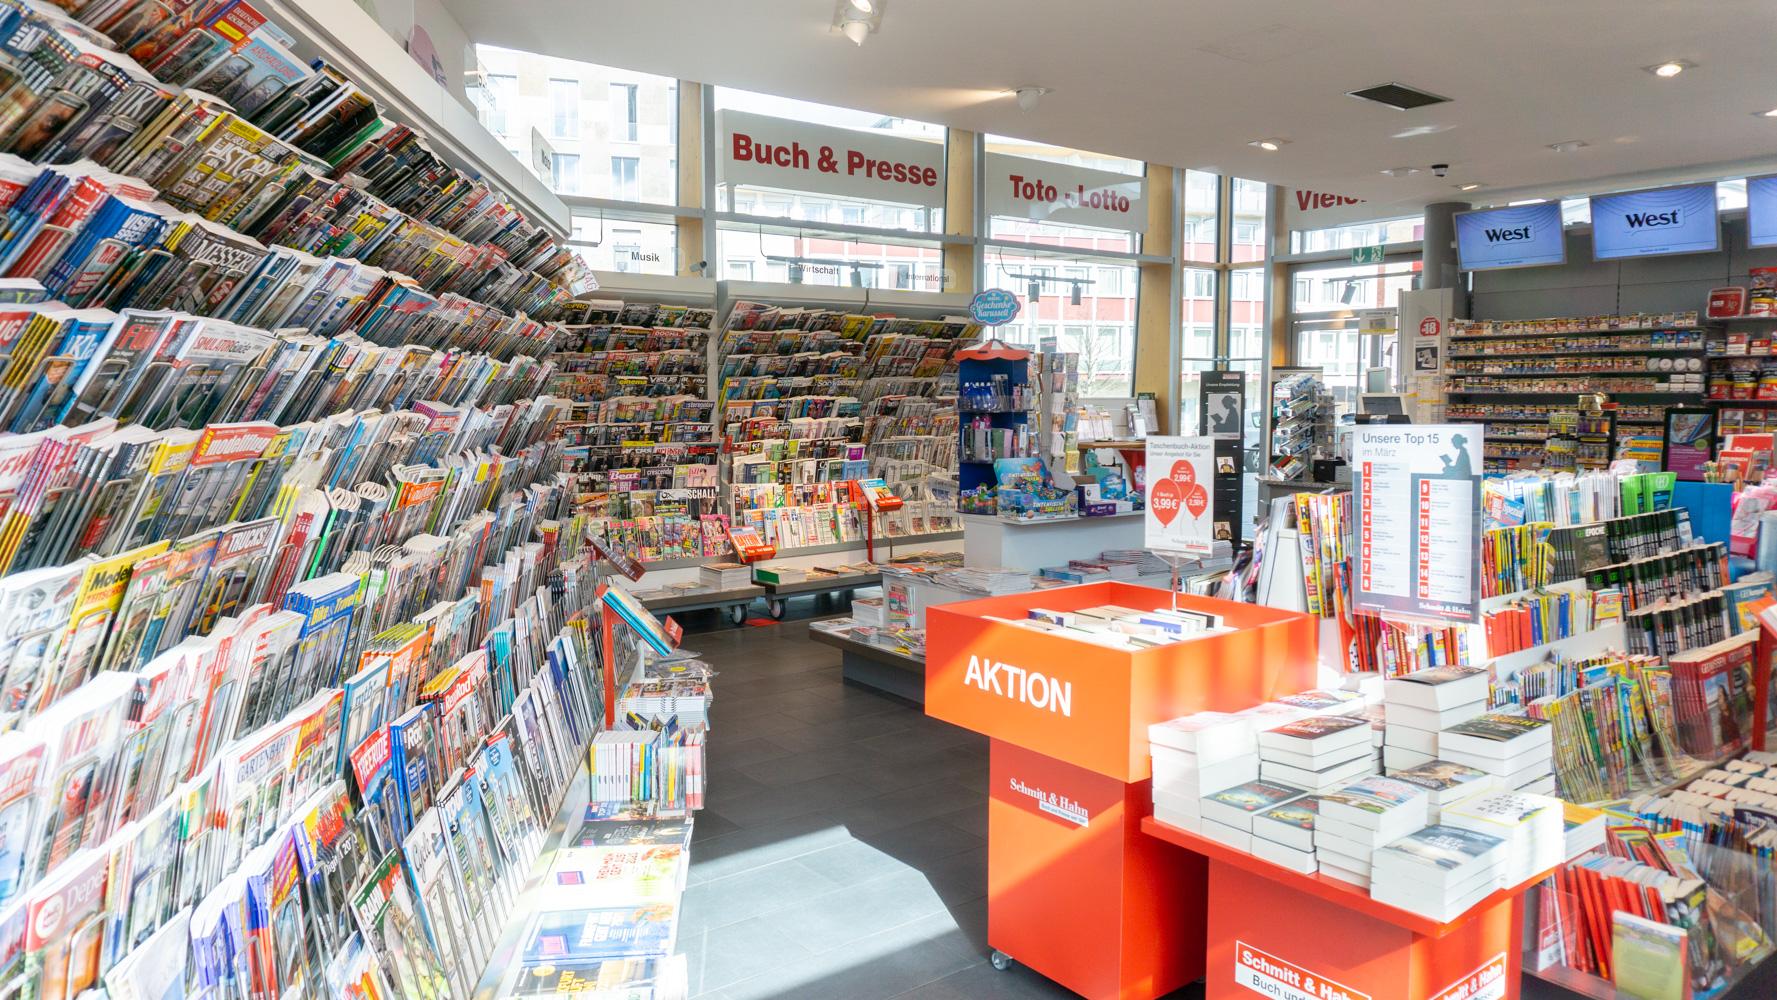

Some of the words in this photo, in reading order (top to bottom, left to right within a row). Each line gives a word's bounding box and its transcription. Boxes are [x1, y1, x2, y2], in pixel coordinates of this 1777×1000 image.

[732, 132, 810, 170] Buch
[817, 146, 839, 173] &
[847, 150, 938, 187] Presse
[1009, 174, 1058, 203] Toto
[1078, 184, 1130, 213] Lotto
[1625, 209, 1679, 228] West
[1484, 226, 1530, 242] West
[193, 240, 255, 272] MESSER
[631, 251, 660, 262] Musik
[799, 264, 839, 275] Wirtschaft
[906, 271, 950, 283] International
[1362, 433, 1401, 444] Unsere
[1404, 433, 1425, 445] Top
[1427, 433, 1440, 444] 15
[1362, 447, 1372, 457] im
[1375, 447, 1397, 457] März
[687, 488, 716, 499] SCHALL
[1420, 500, 1429, 509] 10
[1585, 526, 1605, 537] EPOCHE
[228, 528, 267, 553] TRUCKS
[1420, 534, 1429, 543] 12
[1420, 551, 1428, 561] 13
[1420, 568, 1428, 577] 14
[1419, 585, 1428, 595] 15
[964, 654, 1072, 717] AKTION
[357, 731, 389, 784] FREERIDE
[1010, 777, 1047, 802] Schmitt
[1049, 792, 1058, 806] &
[1060, 795, 1089, 817] Hahn
[1242, 949, 1301, 987] Schmitt
[1304, 977, 1316, 995] &
[1252, 974, 1281, 996] Buch
